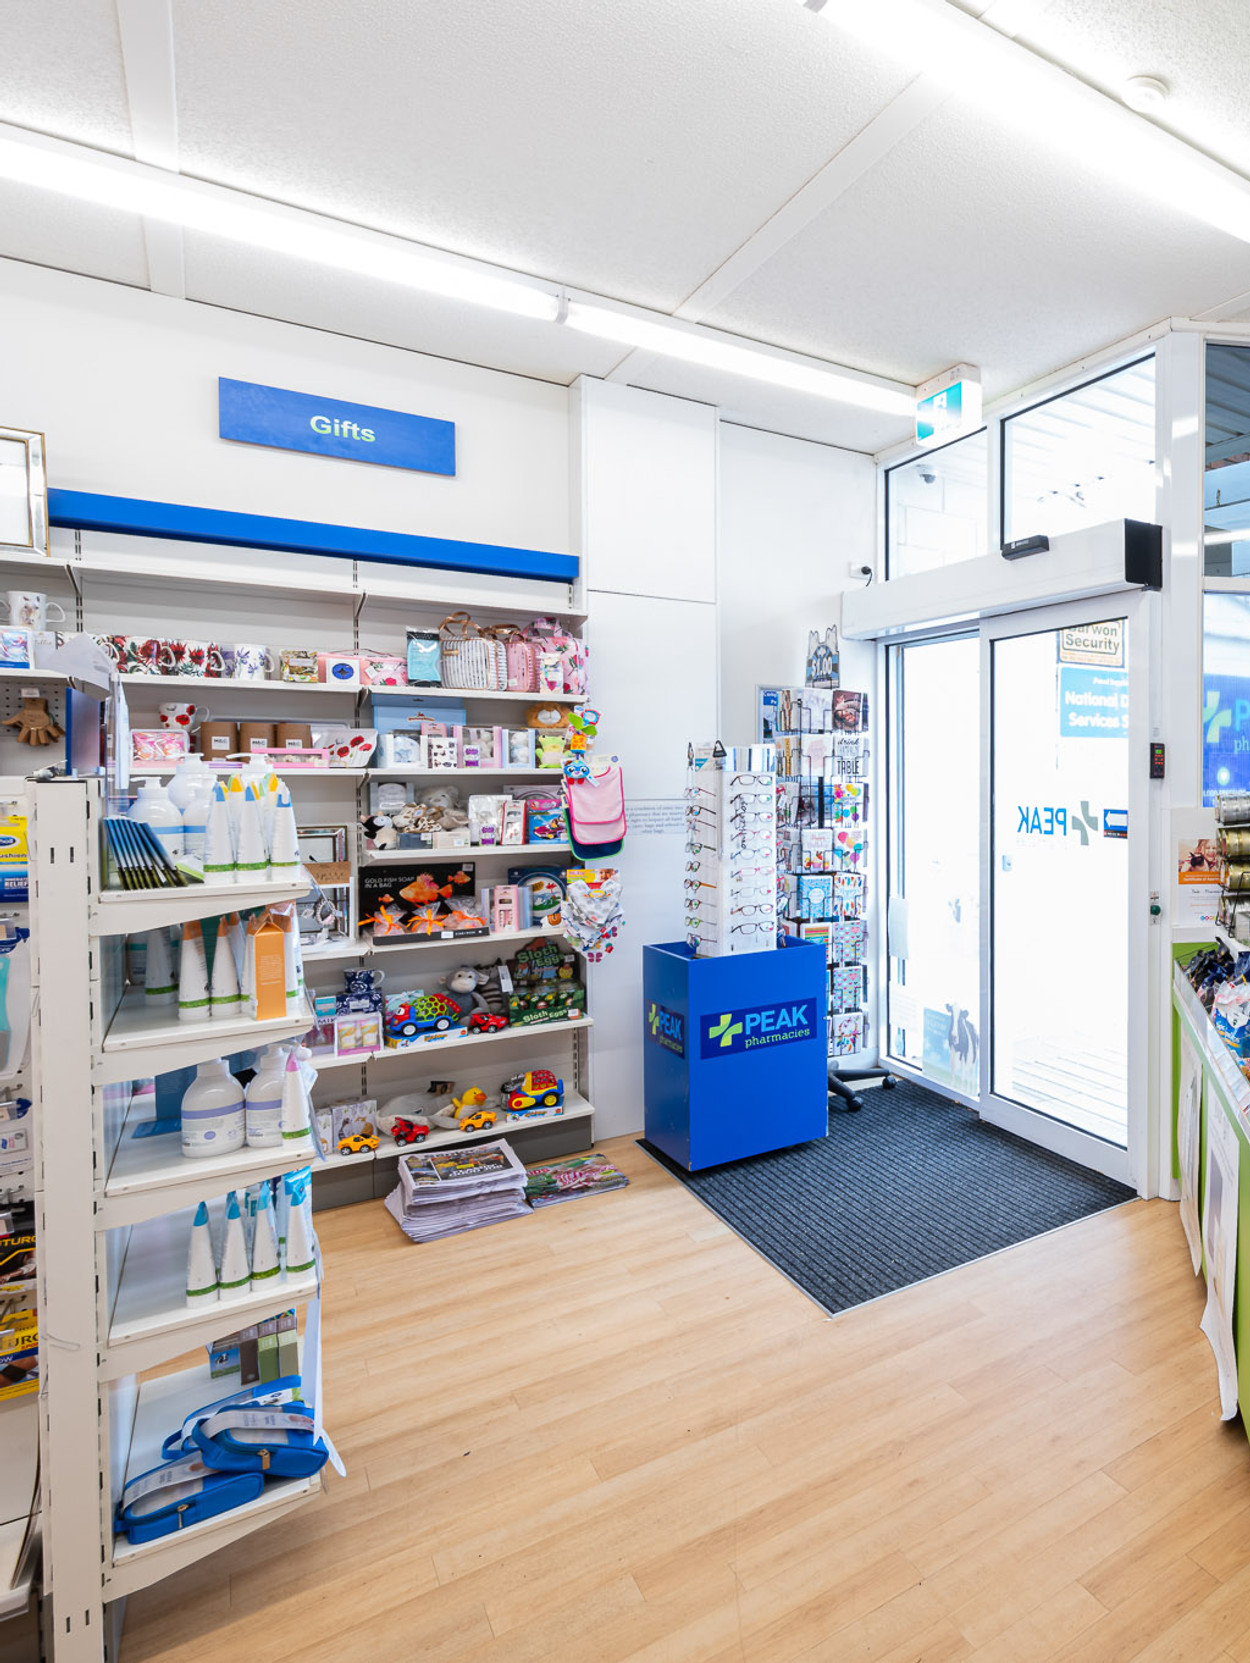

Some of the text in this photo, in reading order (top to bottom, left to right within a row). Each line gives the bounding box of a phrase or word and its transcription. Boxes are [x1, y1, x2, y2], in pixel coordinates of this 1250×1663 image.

[310, 415, 376, 442] Gifts
[1065, 633, 1120, 652] Security
[812, 656, 833, 677] $1.00
[1065, 690, 1119, 709] National
[1069, 712, 1120, 729] Services
[837, 760, 860, 775] TABLE
[365, 875, 415, 885] GOLD FISH SOAP
[516, 945, 558, 964] Sloth
[536, 951, 566, 968] Eggs
[523, 1008, 567, 1024] Sloth Eggs
[659, 1010, 682, 1041] PEAK
[745, 1004, 809, 1035] PEAK
[745, 1028, 811, 1049] pharmacies
